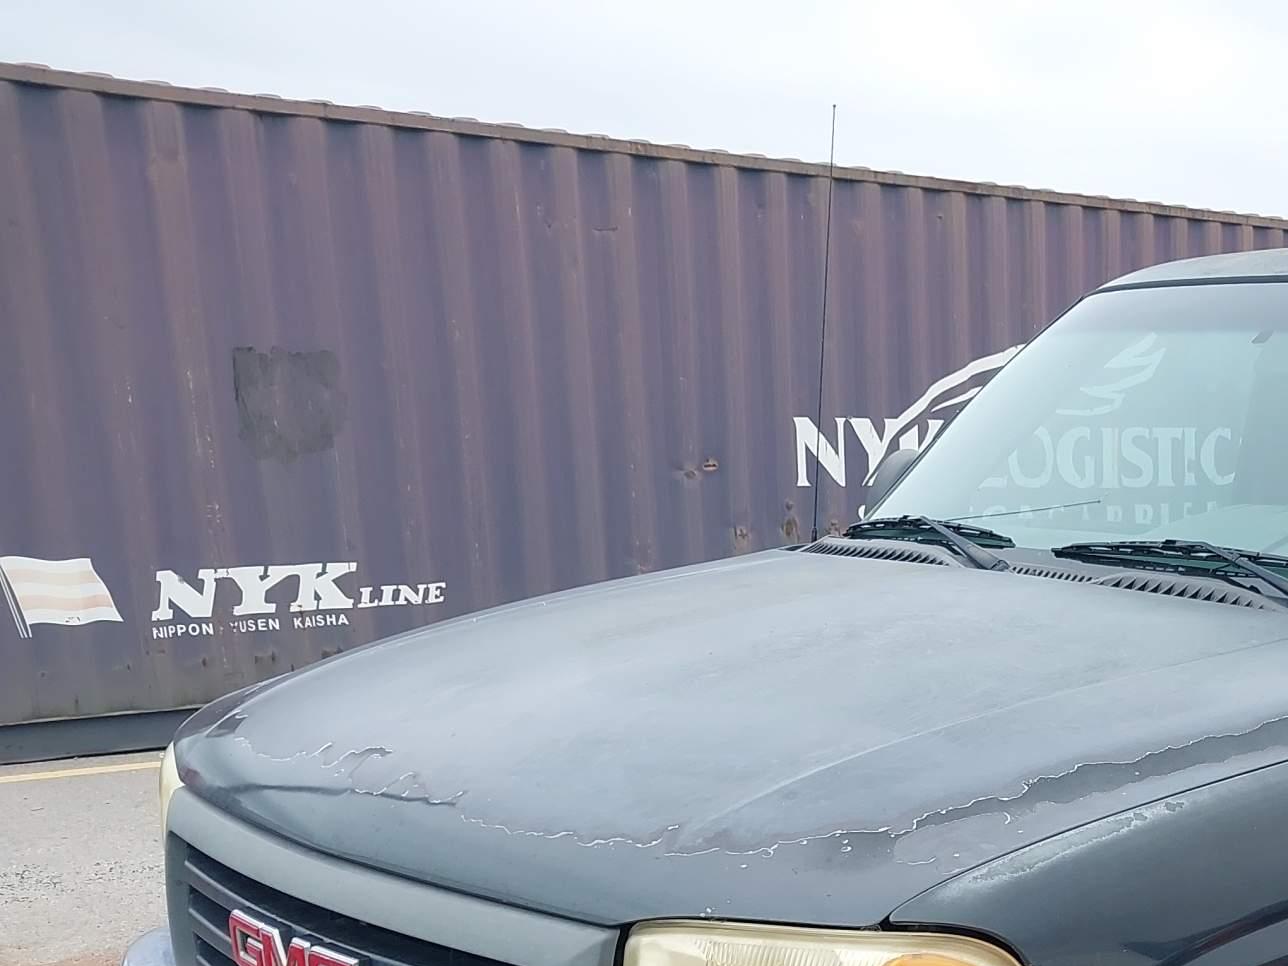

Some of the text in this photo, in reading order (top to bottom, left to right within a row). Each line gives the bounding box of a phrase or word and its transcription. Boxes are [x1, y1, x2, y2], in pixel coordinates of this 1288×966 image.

[151, 562, 447, 621] NYK LINE
[152, 613, 350, 640] NIPPON YUSEN KAISHA
